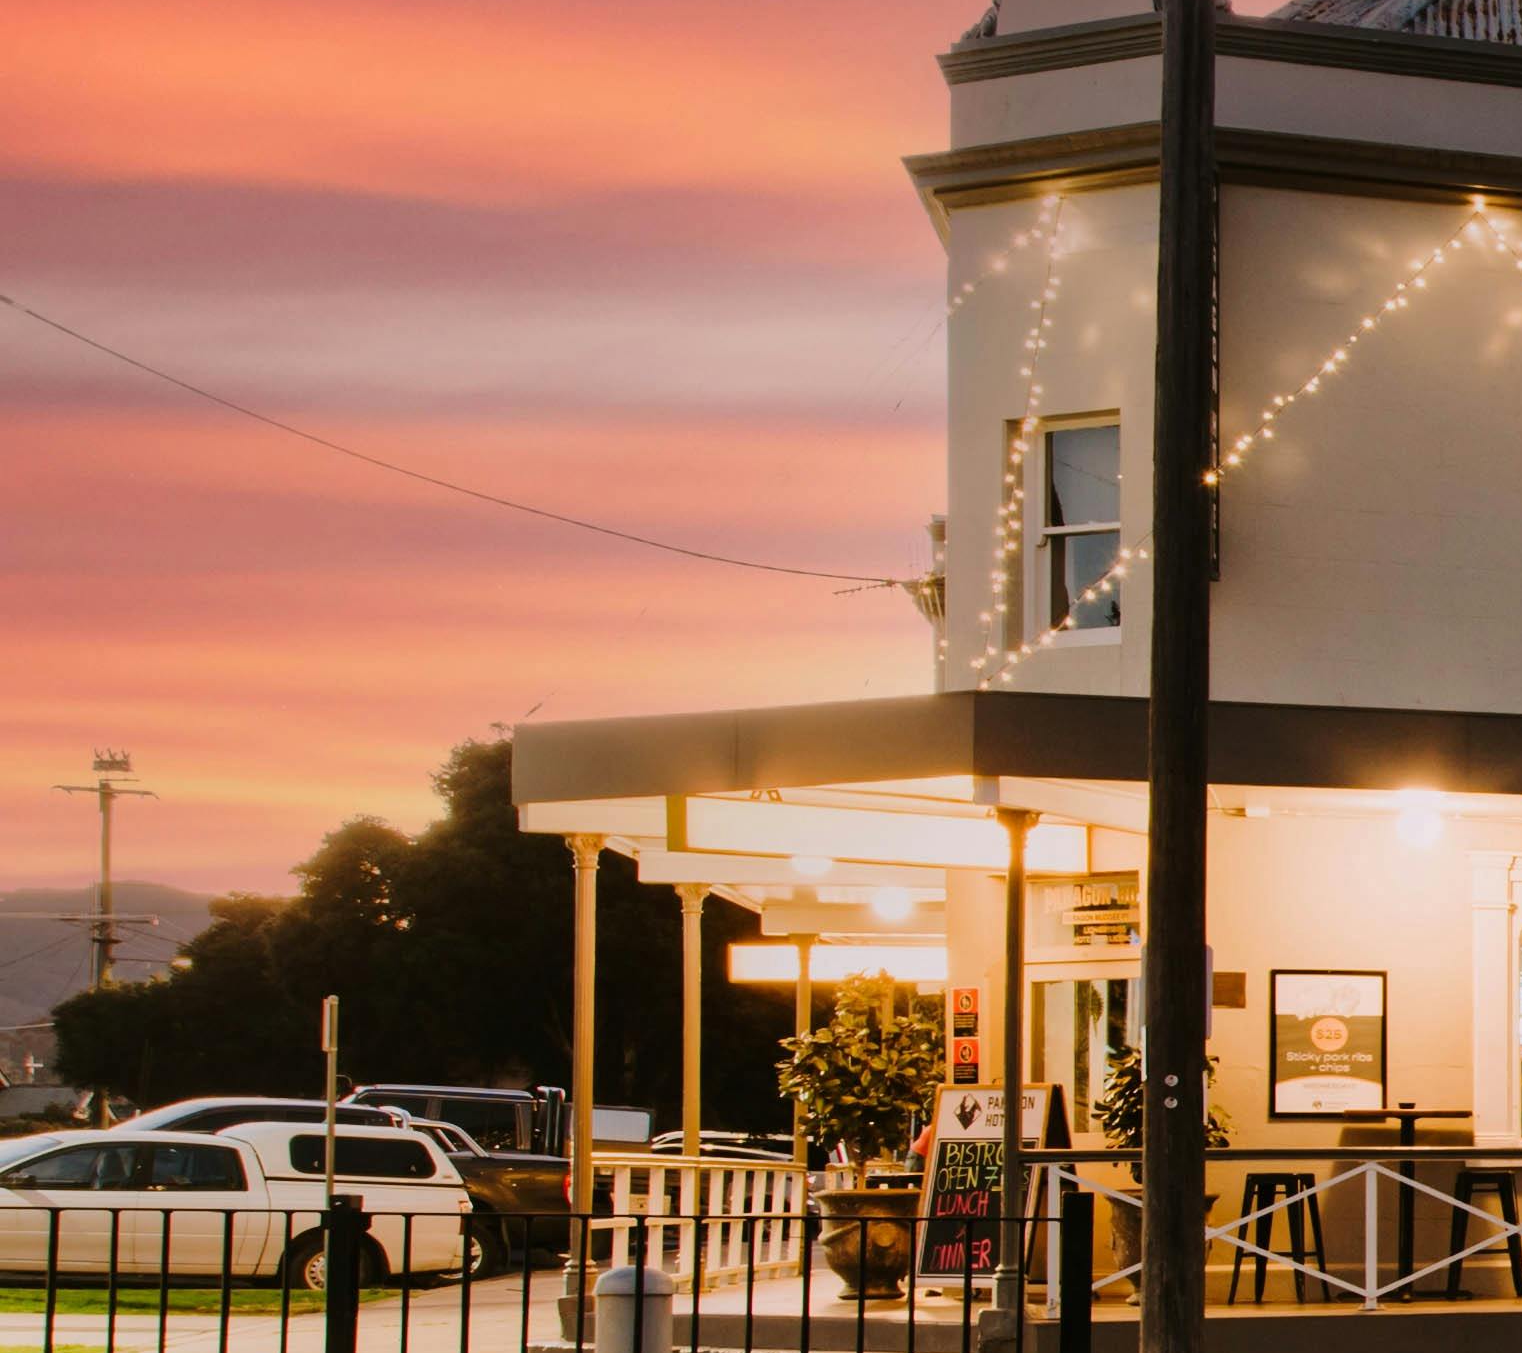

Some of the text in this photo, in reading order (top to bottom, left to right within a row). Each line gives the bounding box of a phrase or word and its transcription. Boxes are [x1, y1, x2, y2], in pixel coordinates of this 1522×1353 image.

[1317, 1029, 1342, 1040] $25
[1286, 1051, 1374, 1063] Sticky pork ribs
[1318, 1062, 1351, 1073] chips
[937, 1166, 979, 1193] OPEN
[985, 1166, 999, 1190] 7
[936, 1191, 990, 1217] LUNCH
